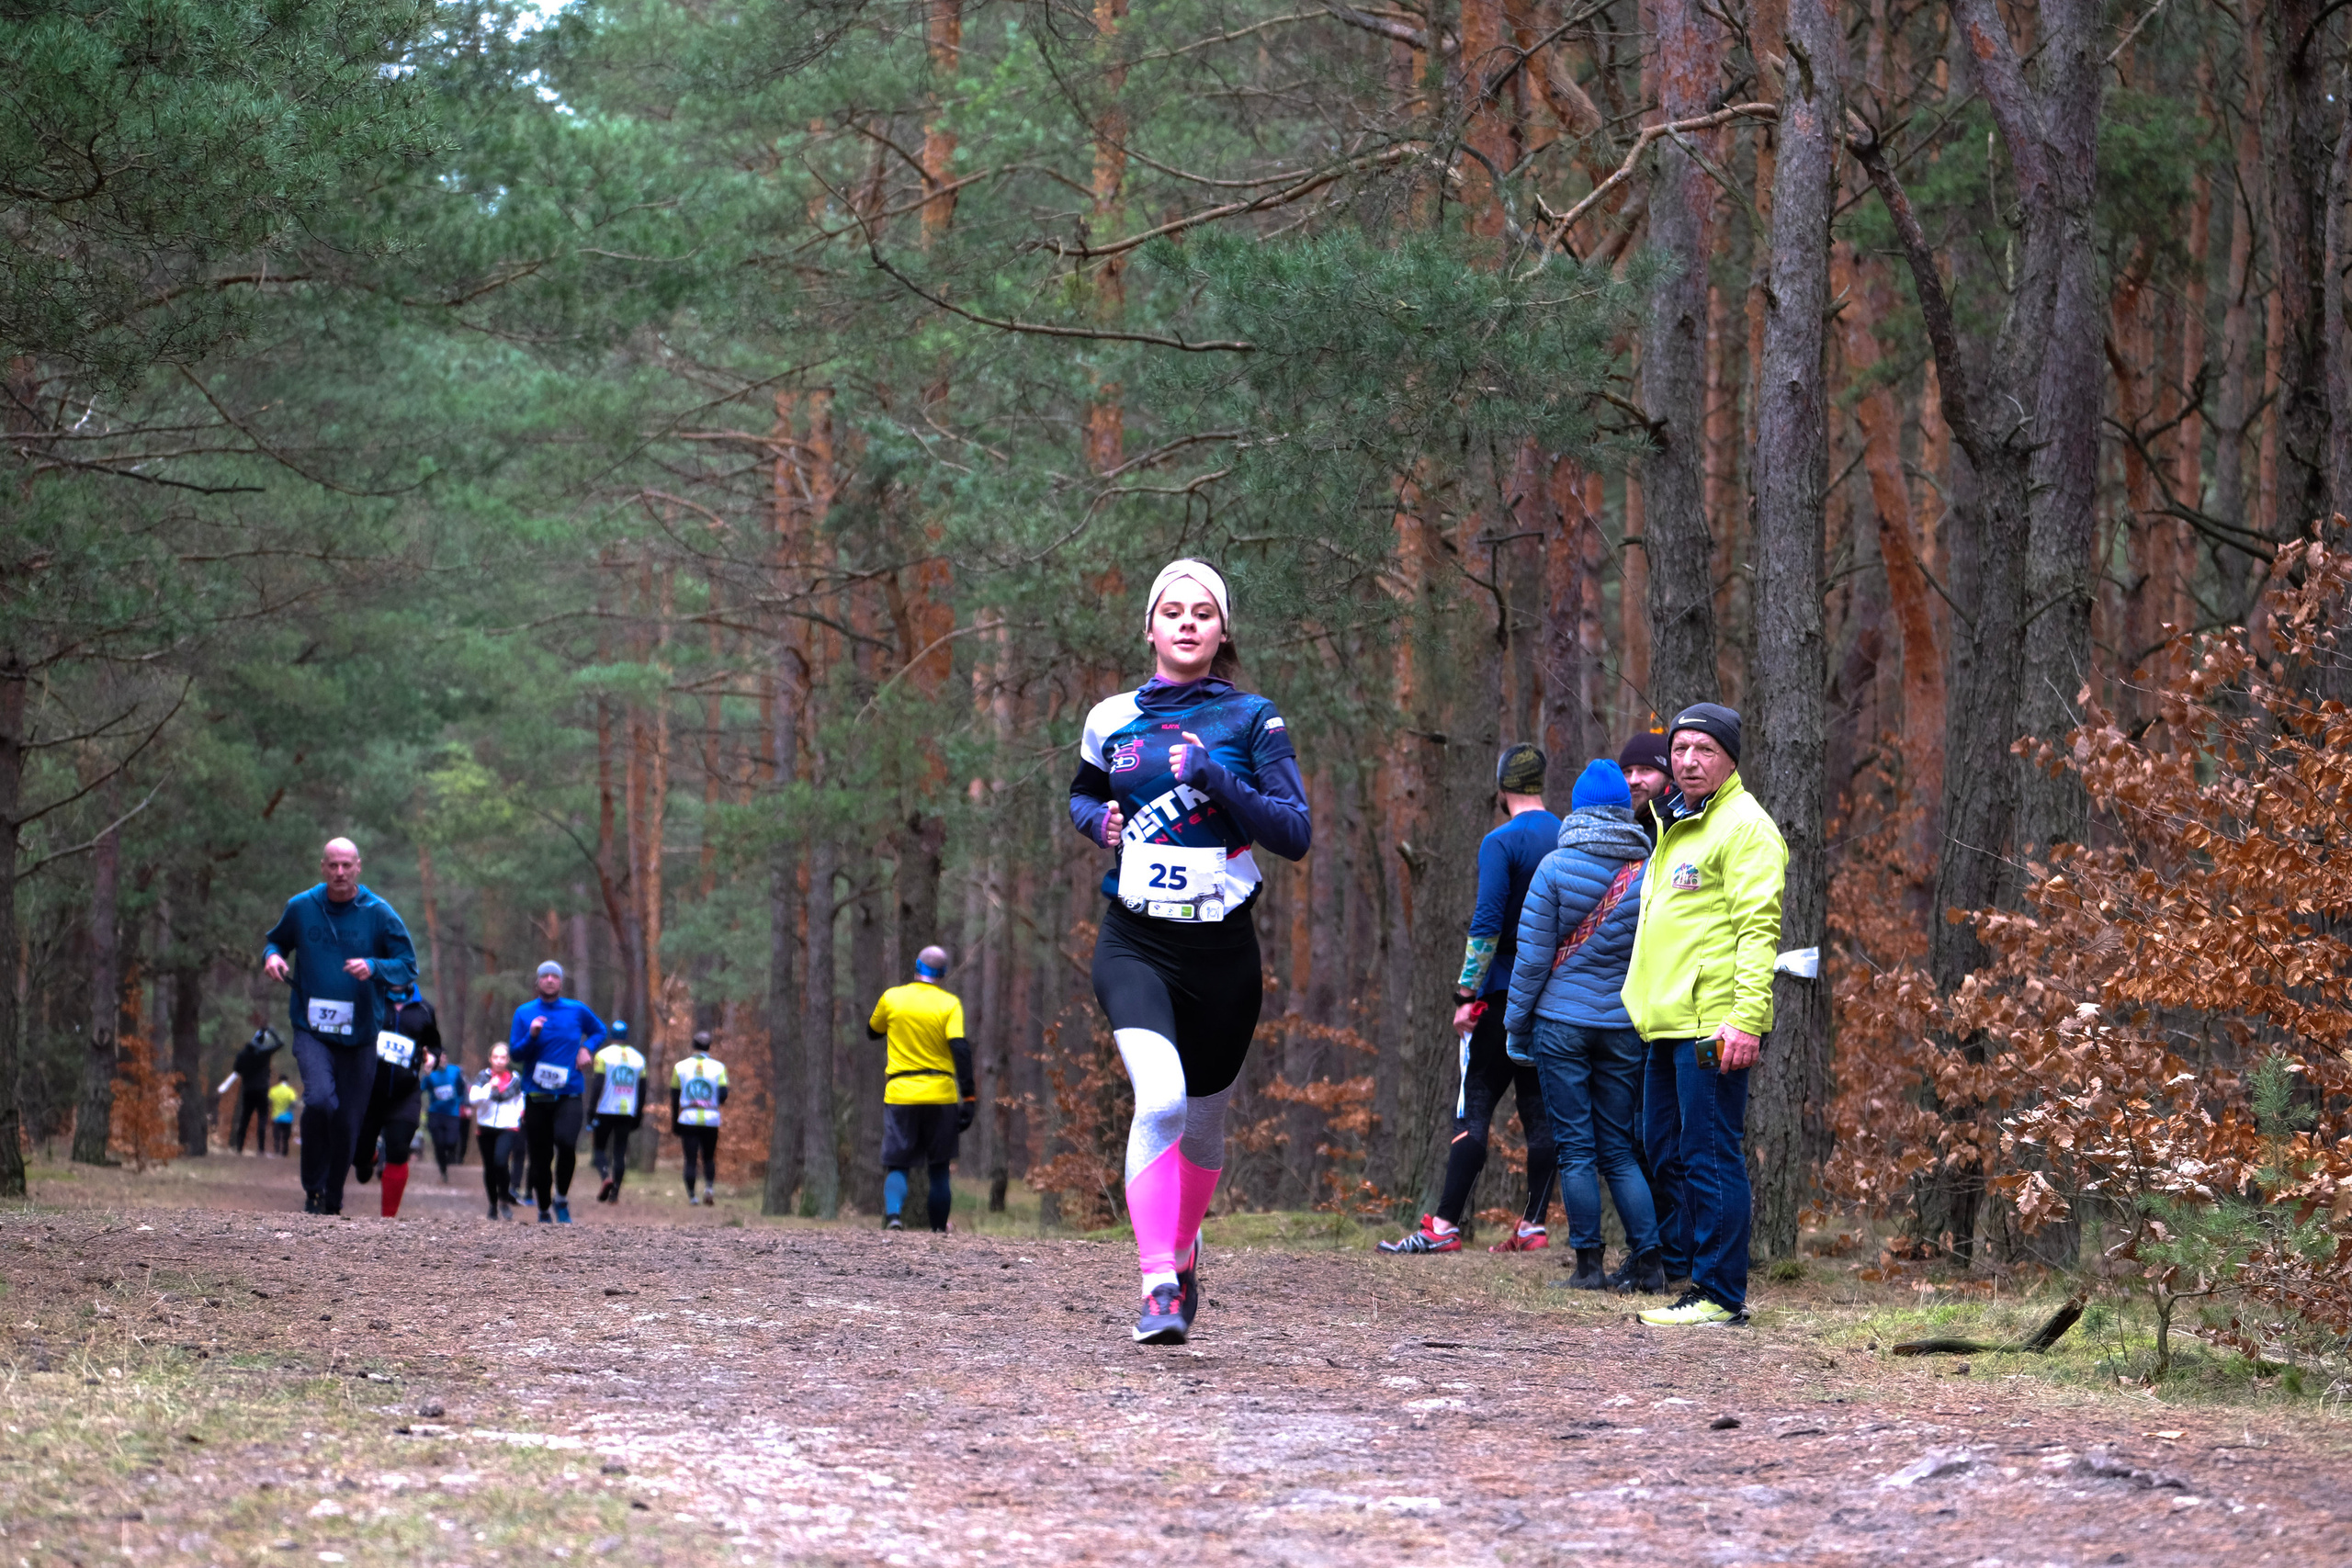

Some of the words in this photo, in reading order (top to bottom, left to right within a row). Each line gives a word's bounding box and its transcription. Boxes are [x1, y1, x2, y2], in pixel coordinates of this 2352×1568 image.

[1148, 863, 1188, 891] 25
[319, 1007, 337, 1021] 37
[384, 1040, 405, 1055] 332
